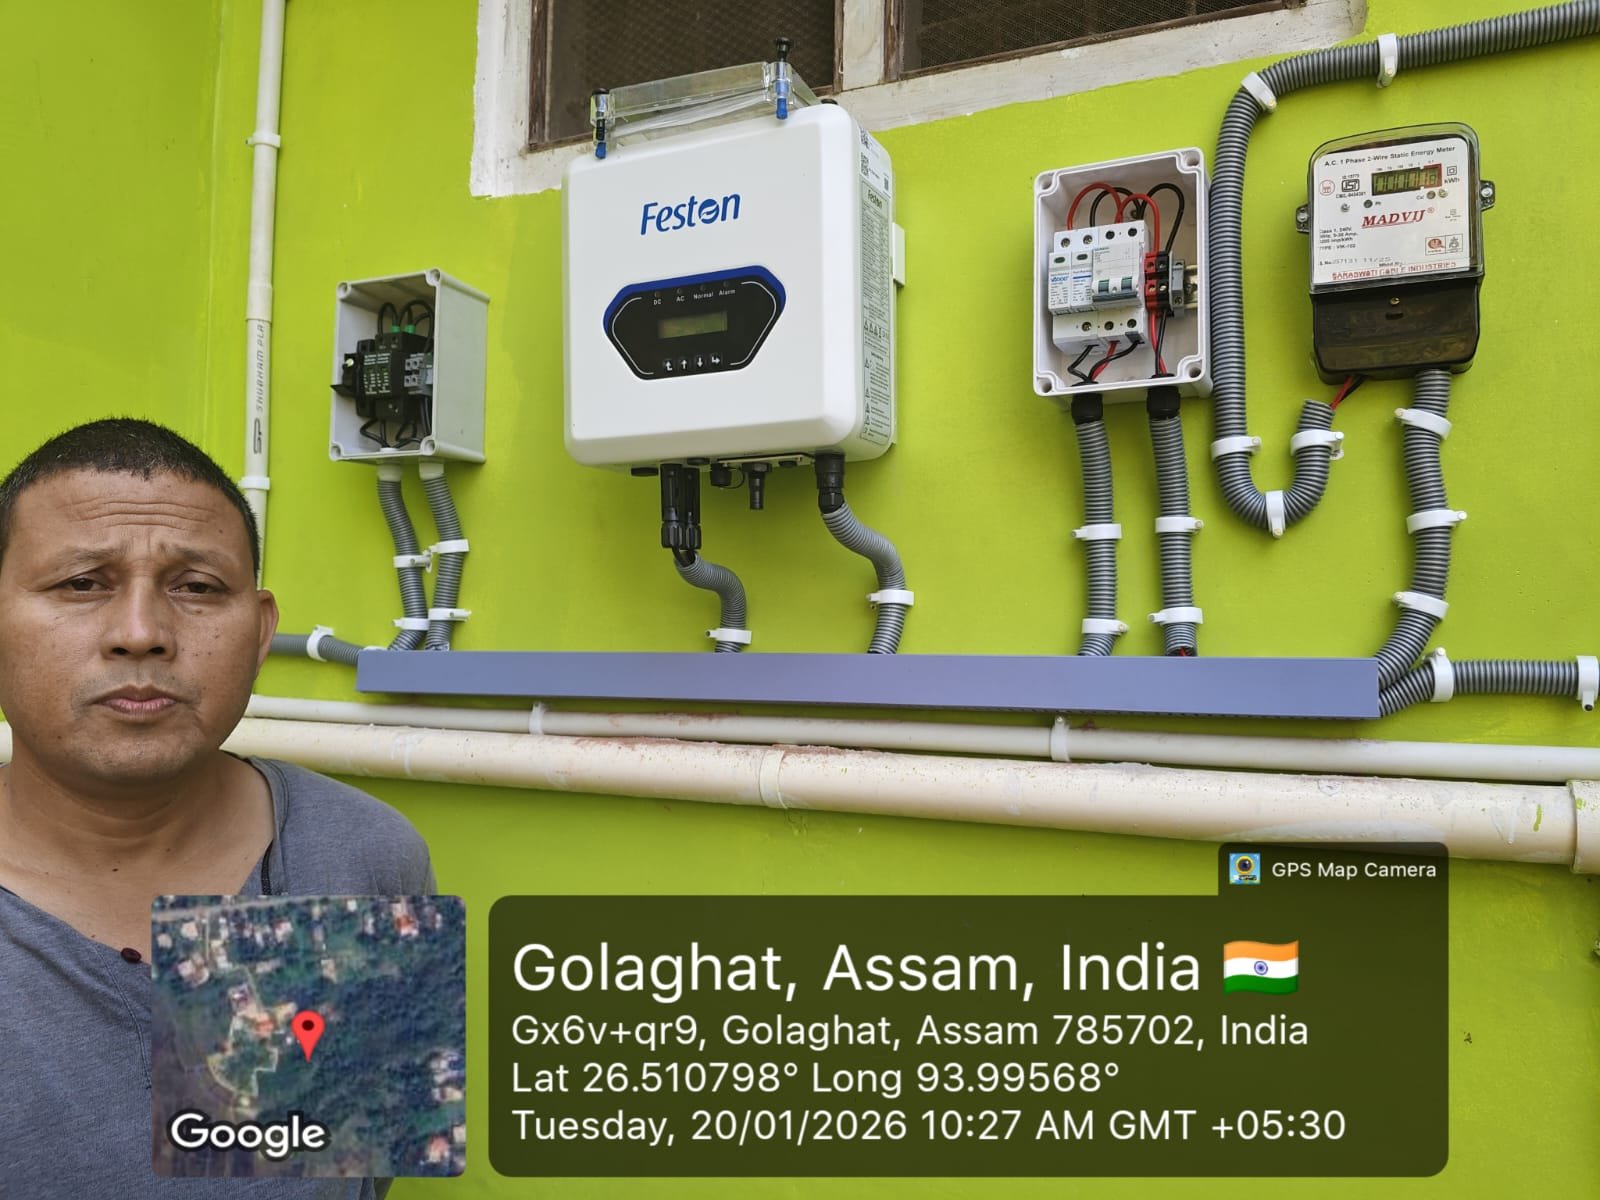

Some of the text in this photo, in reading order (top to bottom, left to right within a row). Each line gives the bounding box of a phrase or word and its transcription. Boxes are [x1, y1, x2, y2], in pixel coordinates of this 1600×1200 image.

[1410, 149, 1435, 157] Energy
[640, 193, 741, 236] Feston
[1361, 209, 1426, 228] MADVIJ
[693, 291, 714, 300] Normal
[718, 288, 736, 297] Alarm
[653, 298, 662, 306] DC
